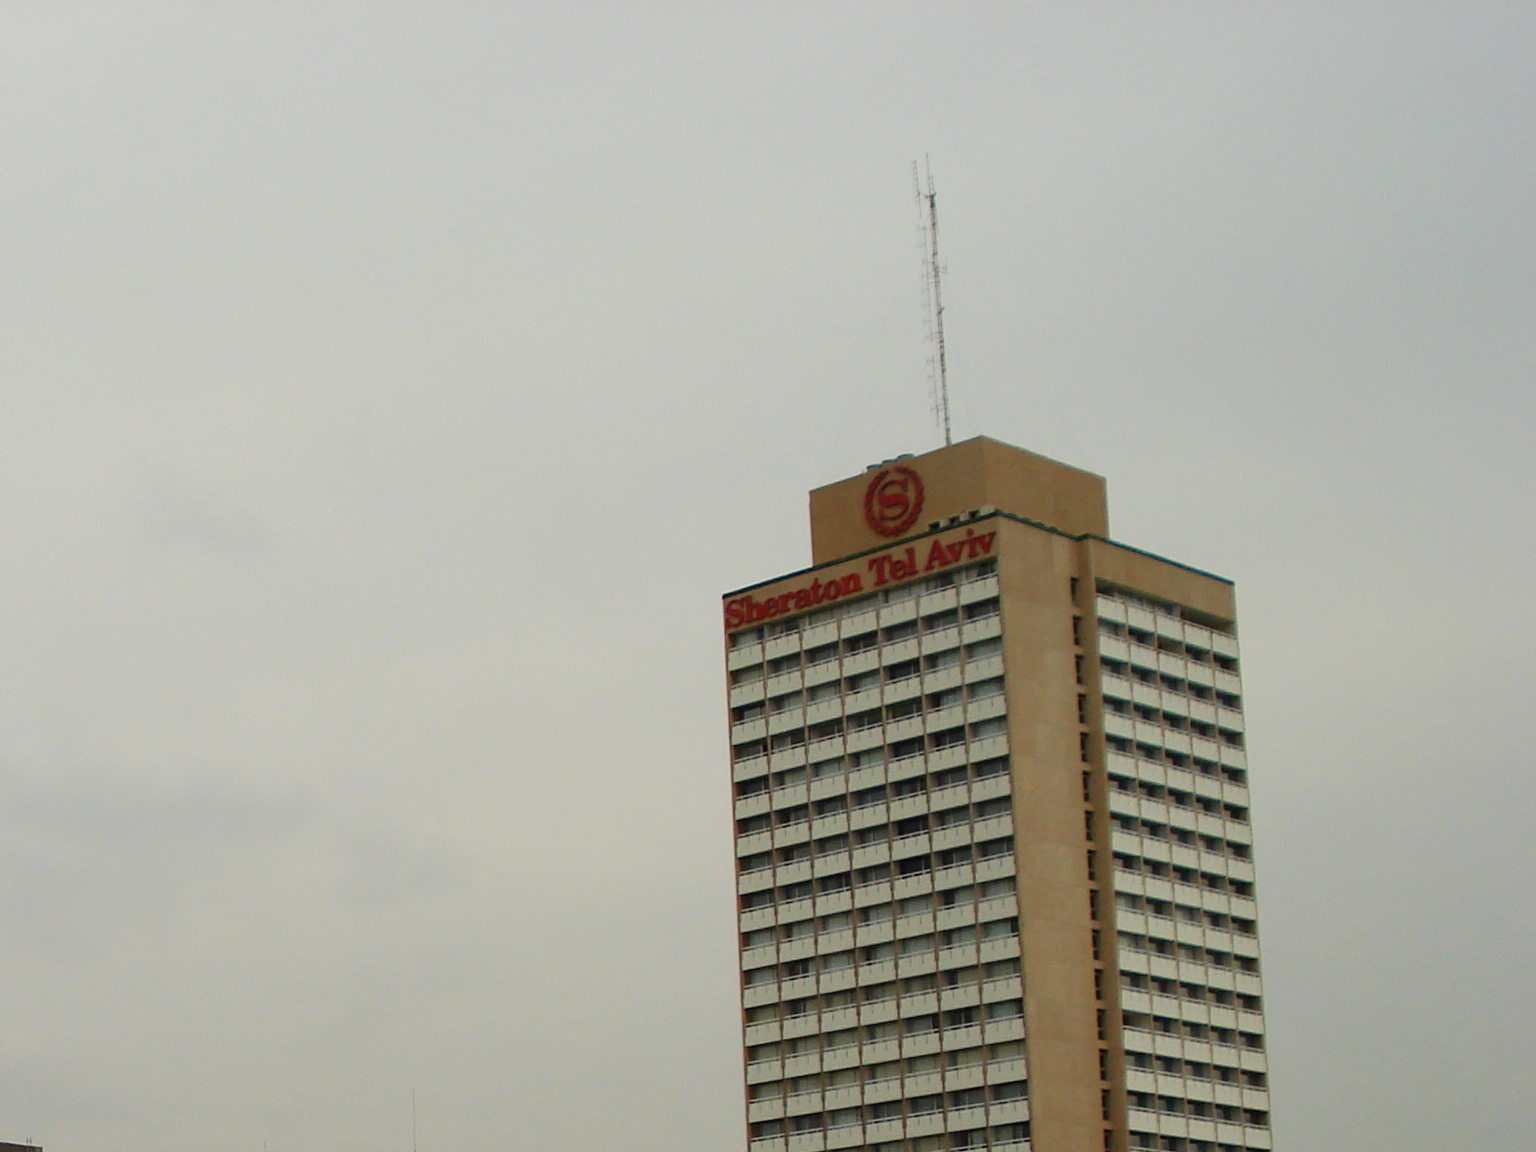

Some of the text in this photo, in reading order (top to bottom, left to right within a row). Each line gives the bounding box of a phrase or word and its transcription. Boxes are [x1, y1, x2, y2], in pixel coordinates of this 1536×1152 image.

[725, 528, 997, 629] Sheraton Tel Aviv
